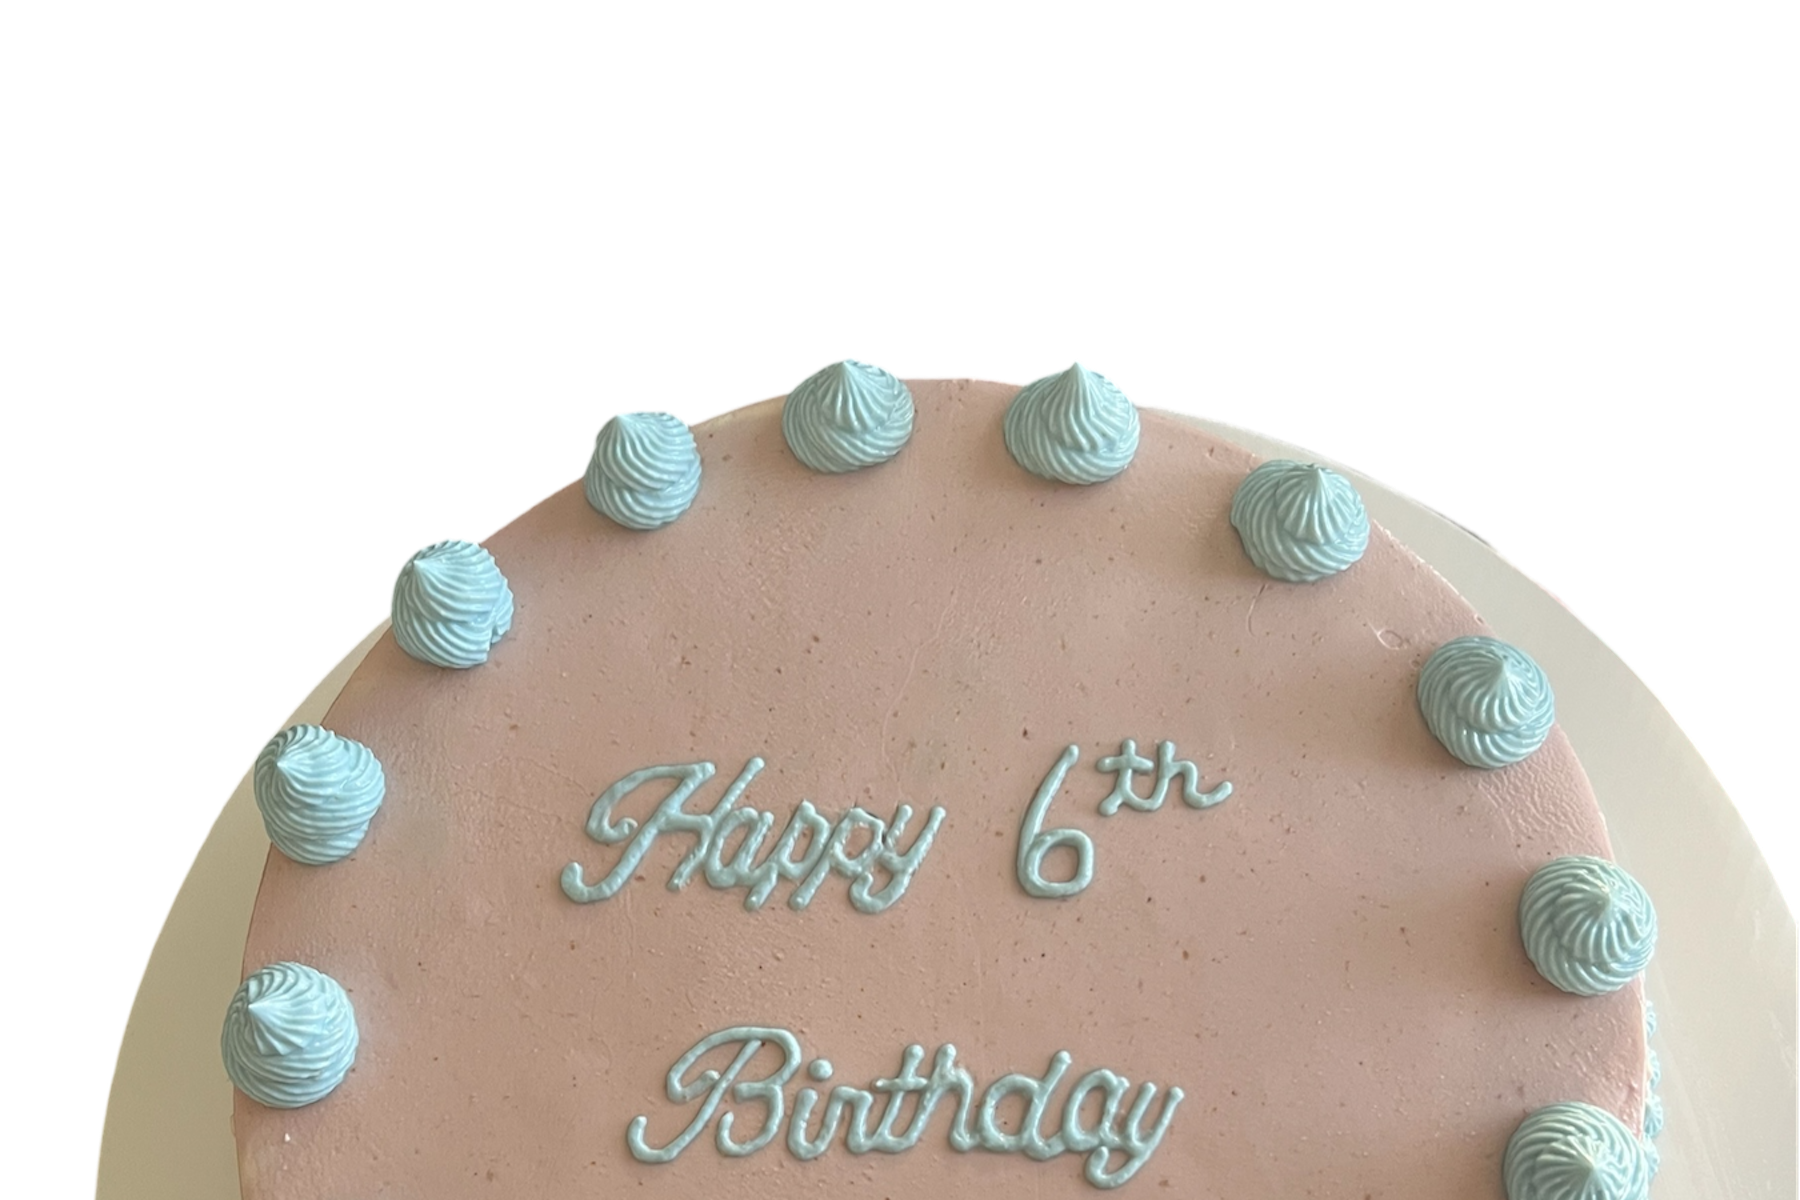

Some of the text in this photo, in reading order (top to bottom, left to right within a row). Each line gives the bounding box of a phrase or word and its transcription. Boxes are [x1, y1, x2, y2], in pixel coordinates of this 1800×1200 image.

[560, 738, 1234, 914] Happy 6th
[627, 1025, 1186, 1190] Birthday
